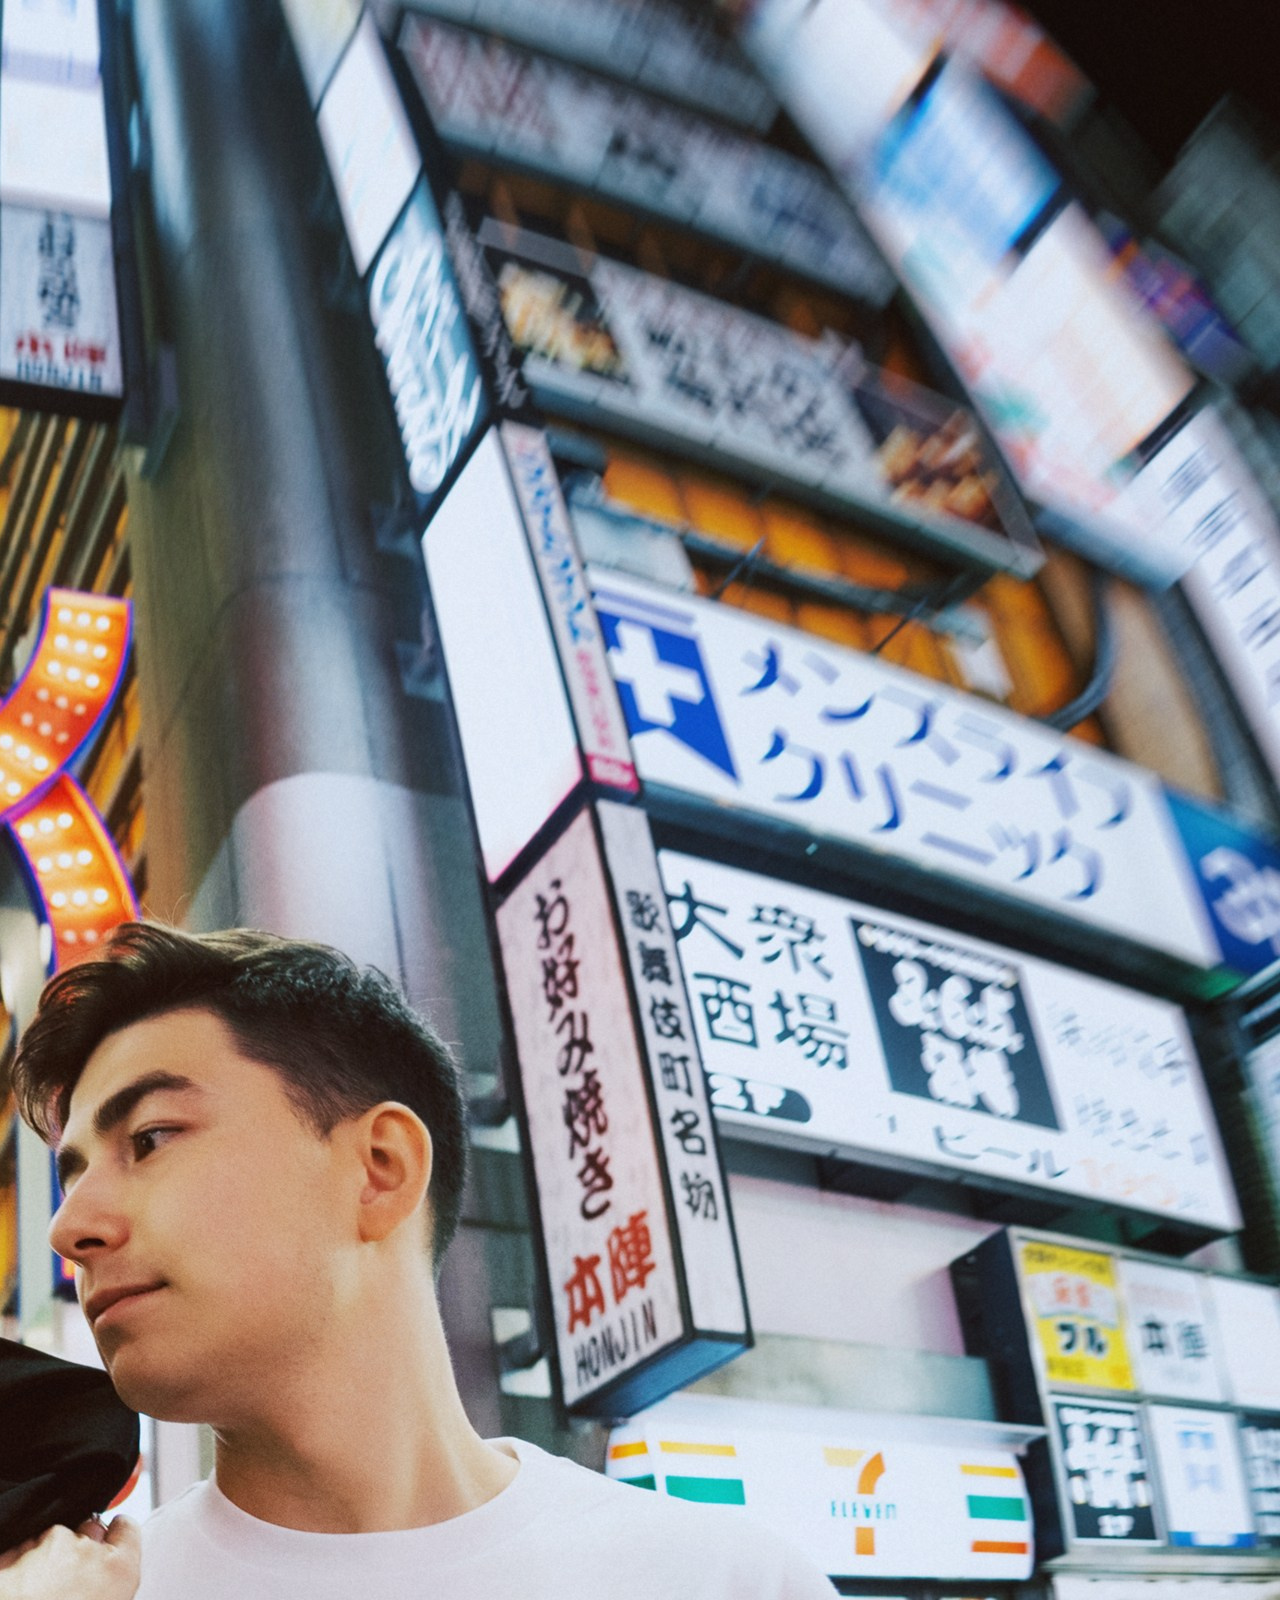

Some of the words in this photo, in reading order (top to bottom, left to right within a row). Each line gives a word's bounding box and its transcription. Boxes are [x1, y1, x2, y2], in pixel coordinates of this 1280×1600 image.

[758, 725, 1104, 902] クリニック
[534, 878, 614, 1219] お好み焼き
[563, 1209, 656, 1335] 本陣
[574, 1299, 657, 1387] HONJIN
